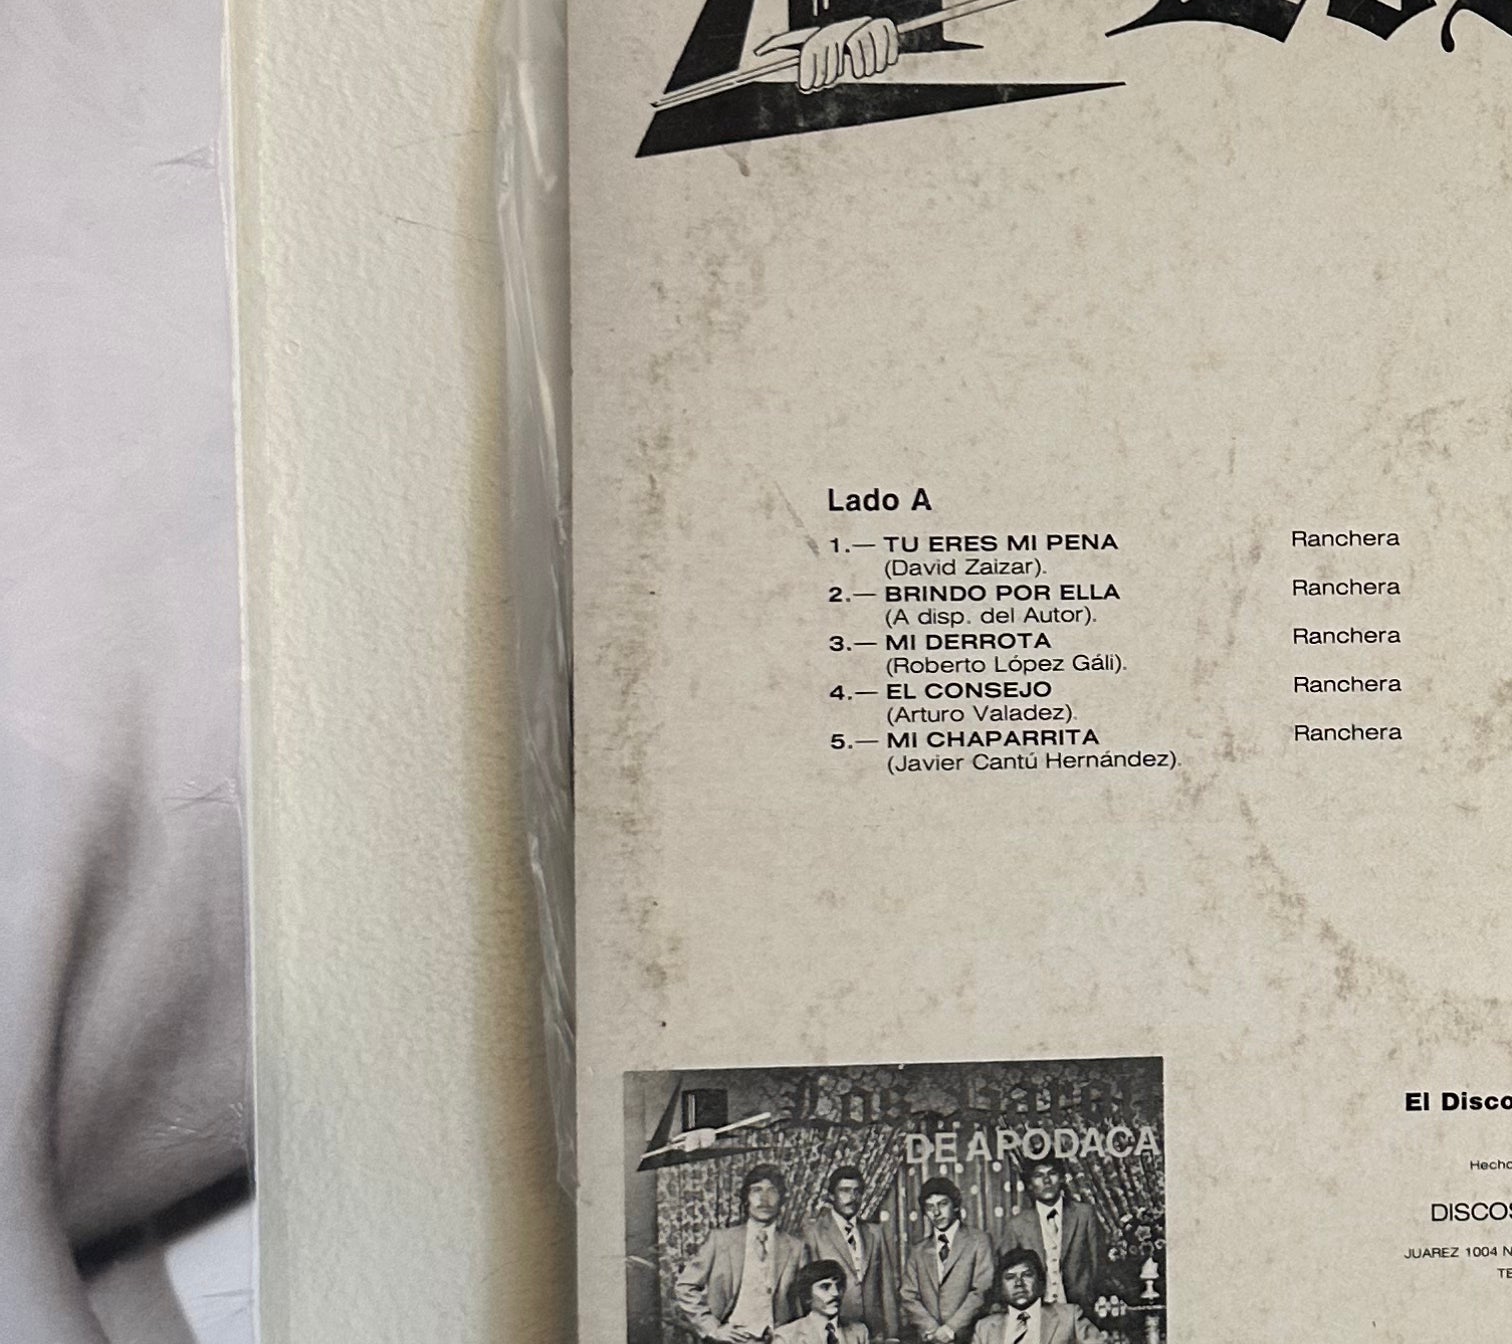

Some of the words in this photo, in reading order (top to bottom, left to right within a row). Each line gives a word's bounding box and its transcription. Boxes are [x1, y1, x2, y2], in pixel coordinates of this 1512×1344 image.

[829, 488, 899, 511] Lado
[911, 488, 932, 510] A
[830, 538, 875, 553] 1.—
[883, 537, 918, 552] TU
[929, 536, 997, 552] ERES
[1008, 535, 1036, 551] MI
[1047, 534, 1118, 550] PENA
[1292, 530, 1400, 547] Ranchera
[885, 559, 956, 580] (David
[965, 558, 1046, 577] Zaizar).
[829, 587, 876, 602] 2.—
[886, 585, 986, 602] BRINDO
[996, 585, 1050, 601] POR
[1060, 584, 1120, 600] ELLA
[1293, 579, 1400, 596] Ranchera
[886, 609, 909, 629] (A
[918, 608, 970, 628] disp.
[981, 608, 1014, 624] del
[1024, 606, 1096, 626] Autor).
[830, 636, 877, 651] 3.—
[886, 635, 915, 650] MI
[926, 633, 1051, 650] DERROTA
[1294, 628, 1401, 644] Ranchera
[887, 657, 985, 677] (Roberto
[995, 655, 1064, 675] López
[1073, 654, 1126, 674] Gáli).
[830, 685, 878, 700] 4.—
[887, 684, 916, 699] EL
[925, 681, 1051, 699] CONSEJO
[1294, 676, 1401, 693] Ranchera
[887, 707, 964, 726] (Arturo
[973, 704, 1078, 723] Valadez).
[831, 734, 878, 749] 5.—
[888, 732, 917, 748] MI
[927, 729, 1099, 747] CHAPARRITA
[1295, 724, 1402, 741] Ranchera
[888, 755, 964, 775] (Javier
[973, 752, 1037, 770] Cantú
[1046, 751, 1182, 770] Hernández).
[1406, 1092, 1429, 1111] El
[905, 1132, 958, 1164] DE
[967, 1126, 1161, 1160] APODACA
[1404, 1248, 1459, 1259] JUAREZ
[1466, 1247, 1498, 1257] 1004
